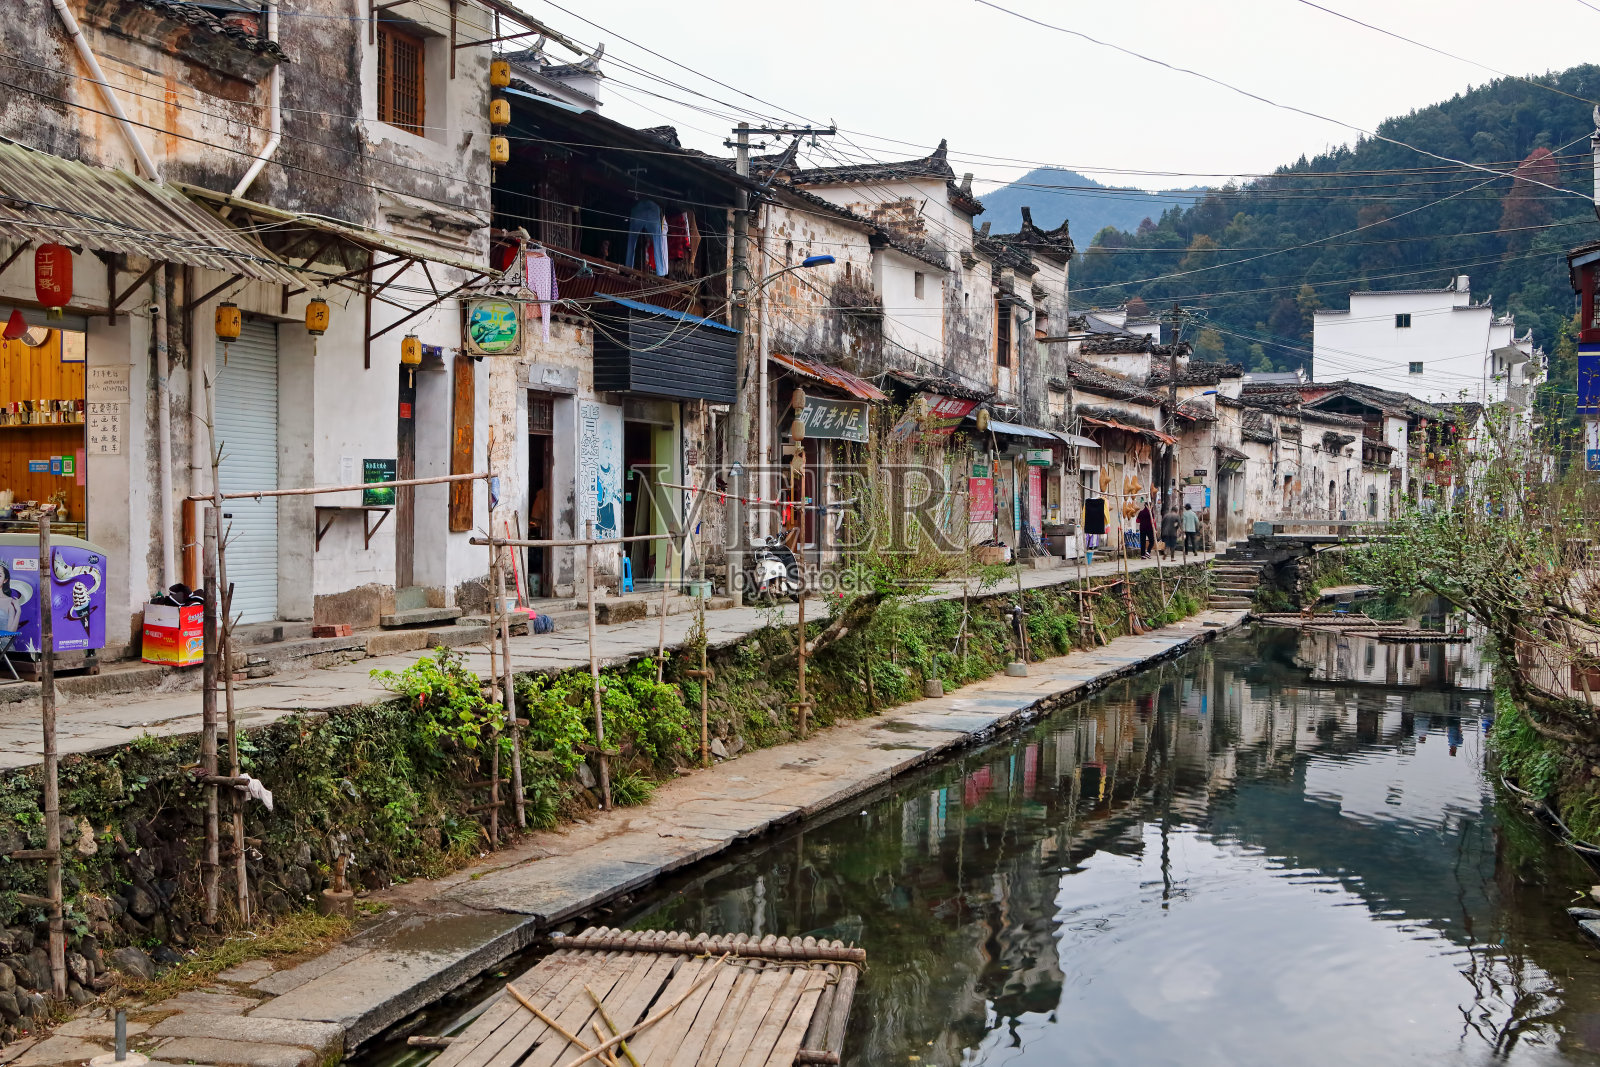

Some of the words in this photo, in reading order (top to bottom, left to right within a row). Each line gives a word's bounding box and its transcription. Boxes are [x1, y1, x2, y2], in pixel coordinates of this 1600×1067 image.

[799, 403, 860, 431] 向阳老木匠
